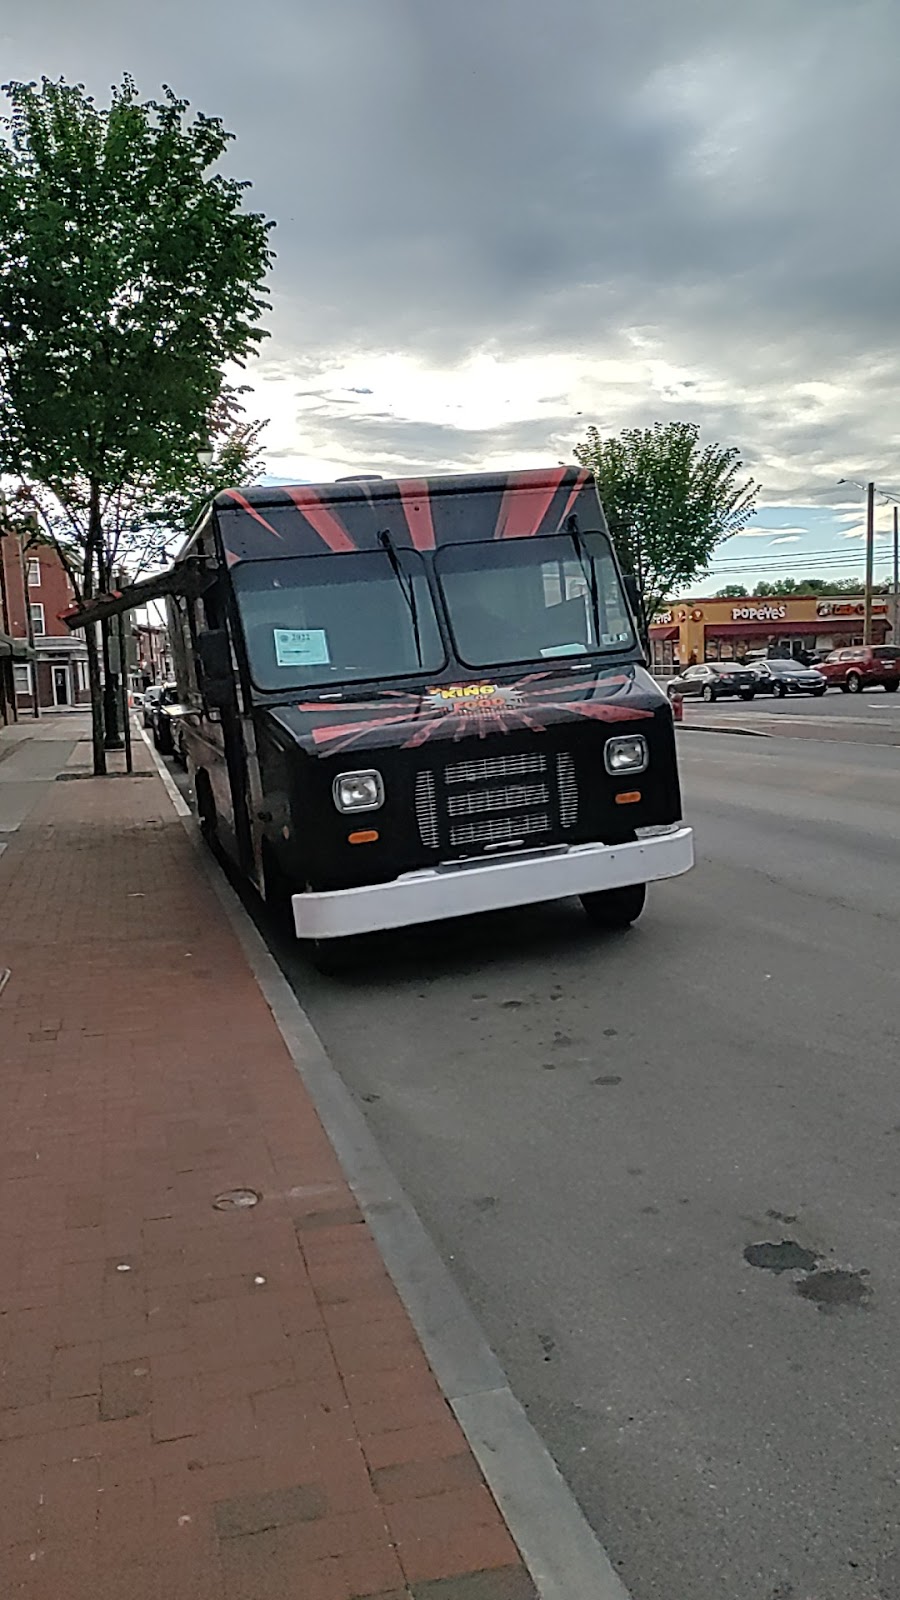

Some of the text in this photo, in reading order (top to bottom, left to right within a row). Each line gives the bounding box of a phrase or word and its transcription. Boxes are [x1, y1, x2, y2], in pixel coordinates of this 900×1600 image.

[732, 606, 786, 620] POPEYES
[441, 685, 495, 699] KING
[453, 698, 506, 713] FOOD
